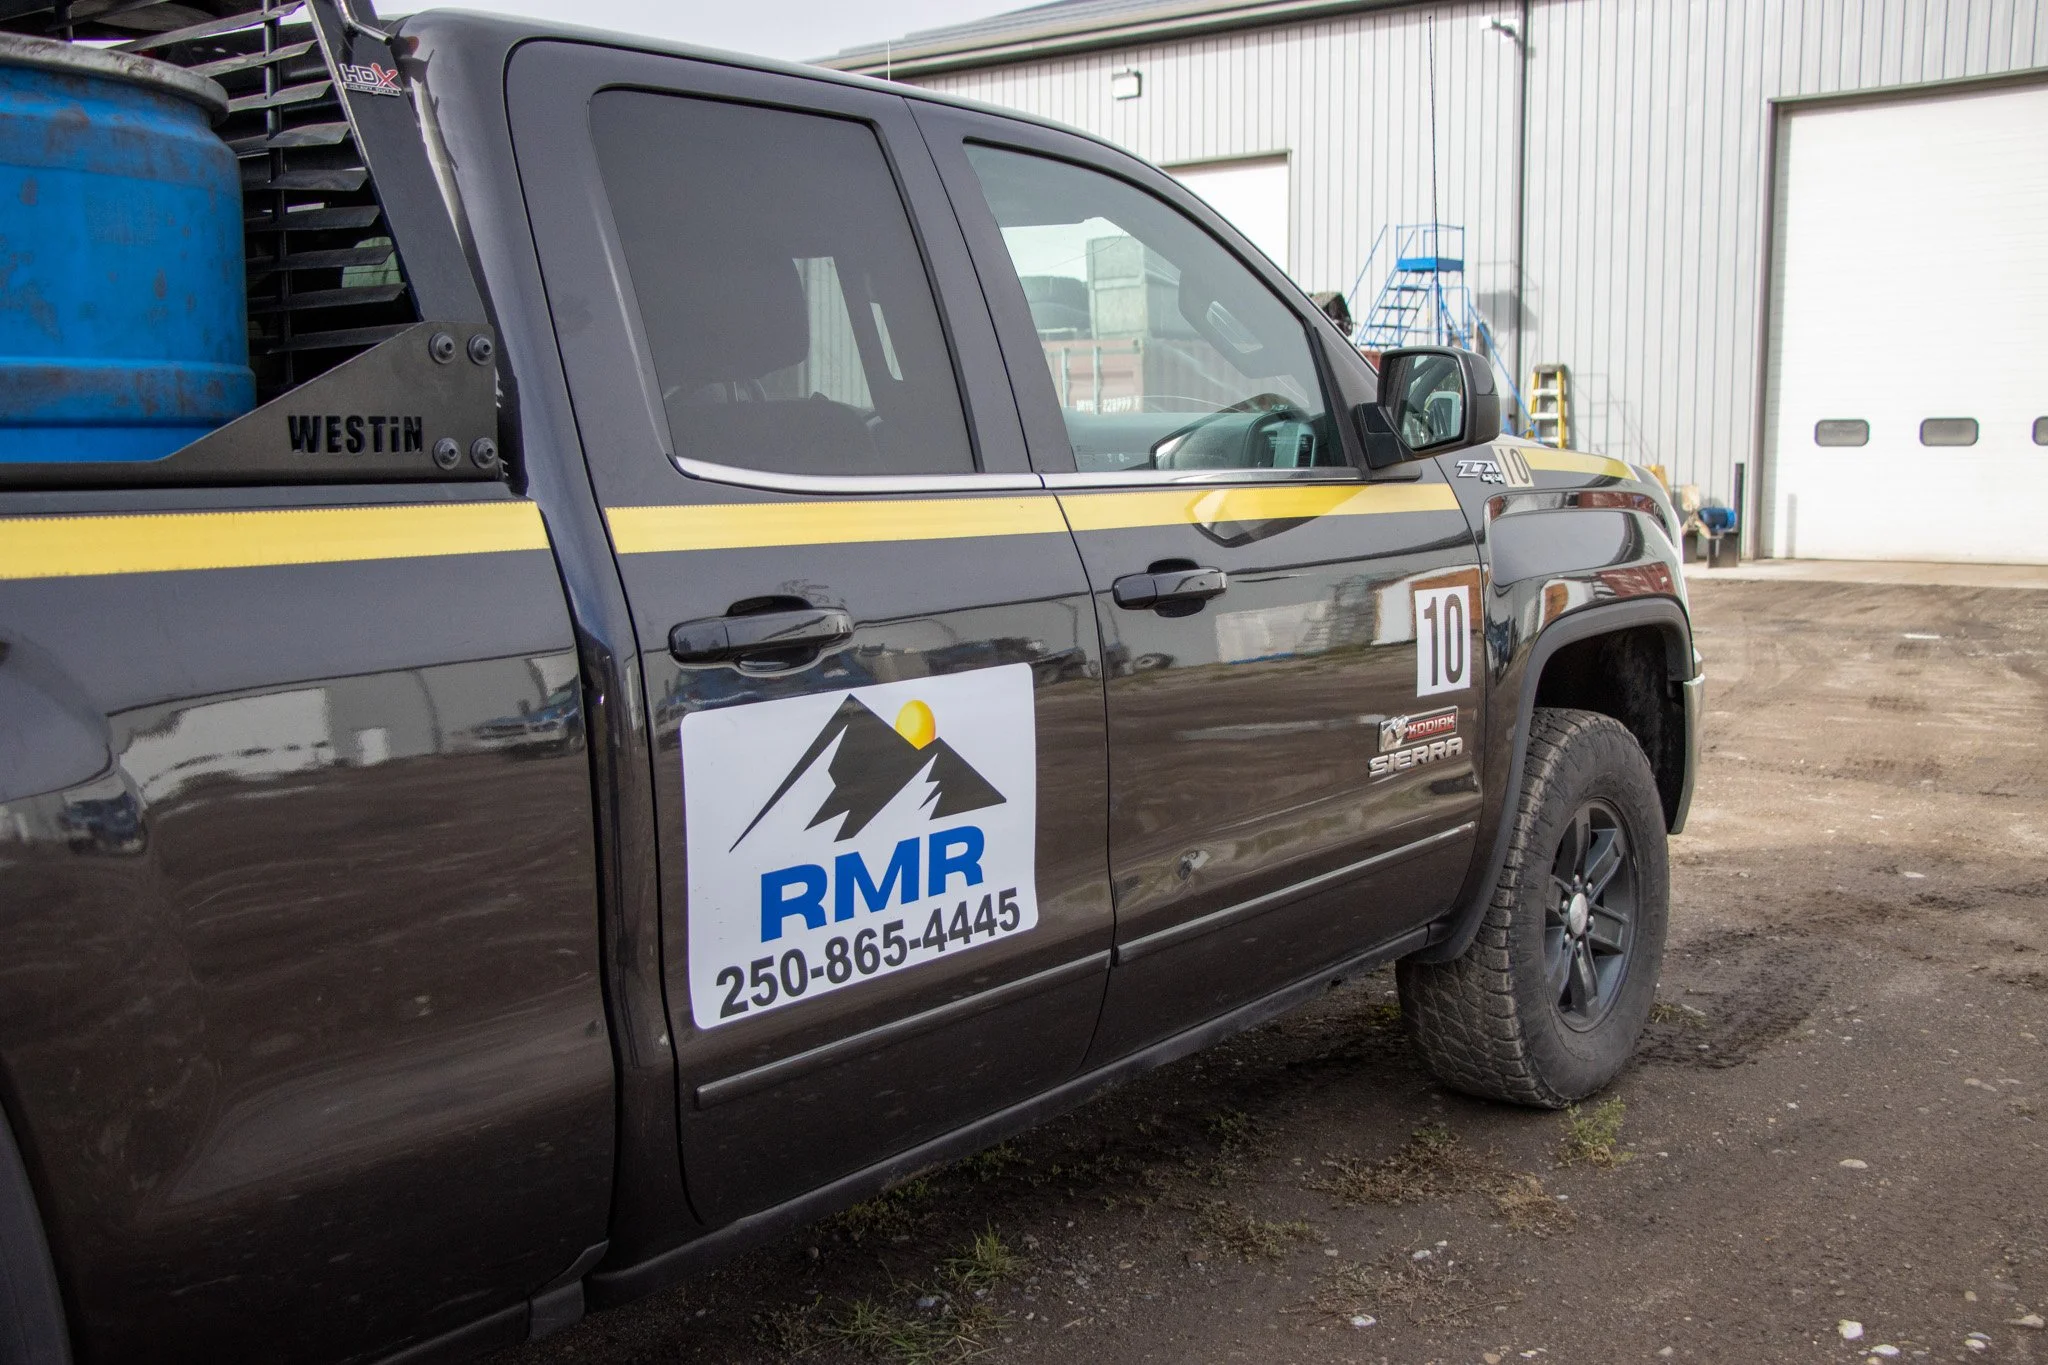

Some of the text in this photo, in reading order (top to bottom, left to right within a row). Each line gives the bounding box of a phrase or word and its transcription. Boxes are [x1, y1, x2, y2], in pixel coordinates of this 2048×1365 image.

[339, 63, 401, 91] HDX
[1499, 448, 1529, 484] 10
[1424, 593, 1464, 687] 10
[1408, 714, 1455, 735] KODIAK
[1368, 737, 1463, 777] SIERRA
[760, 825, 985, 943] RMR
[715, 887, 1021, 1019] 250-865-4445
